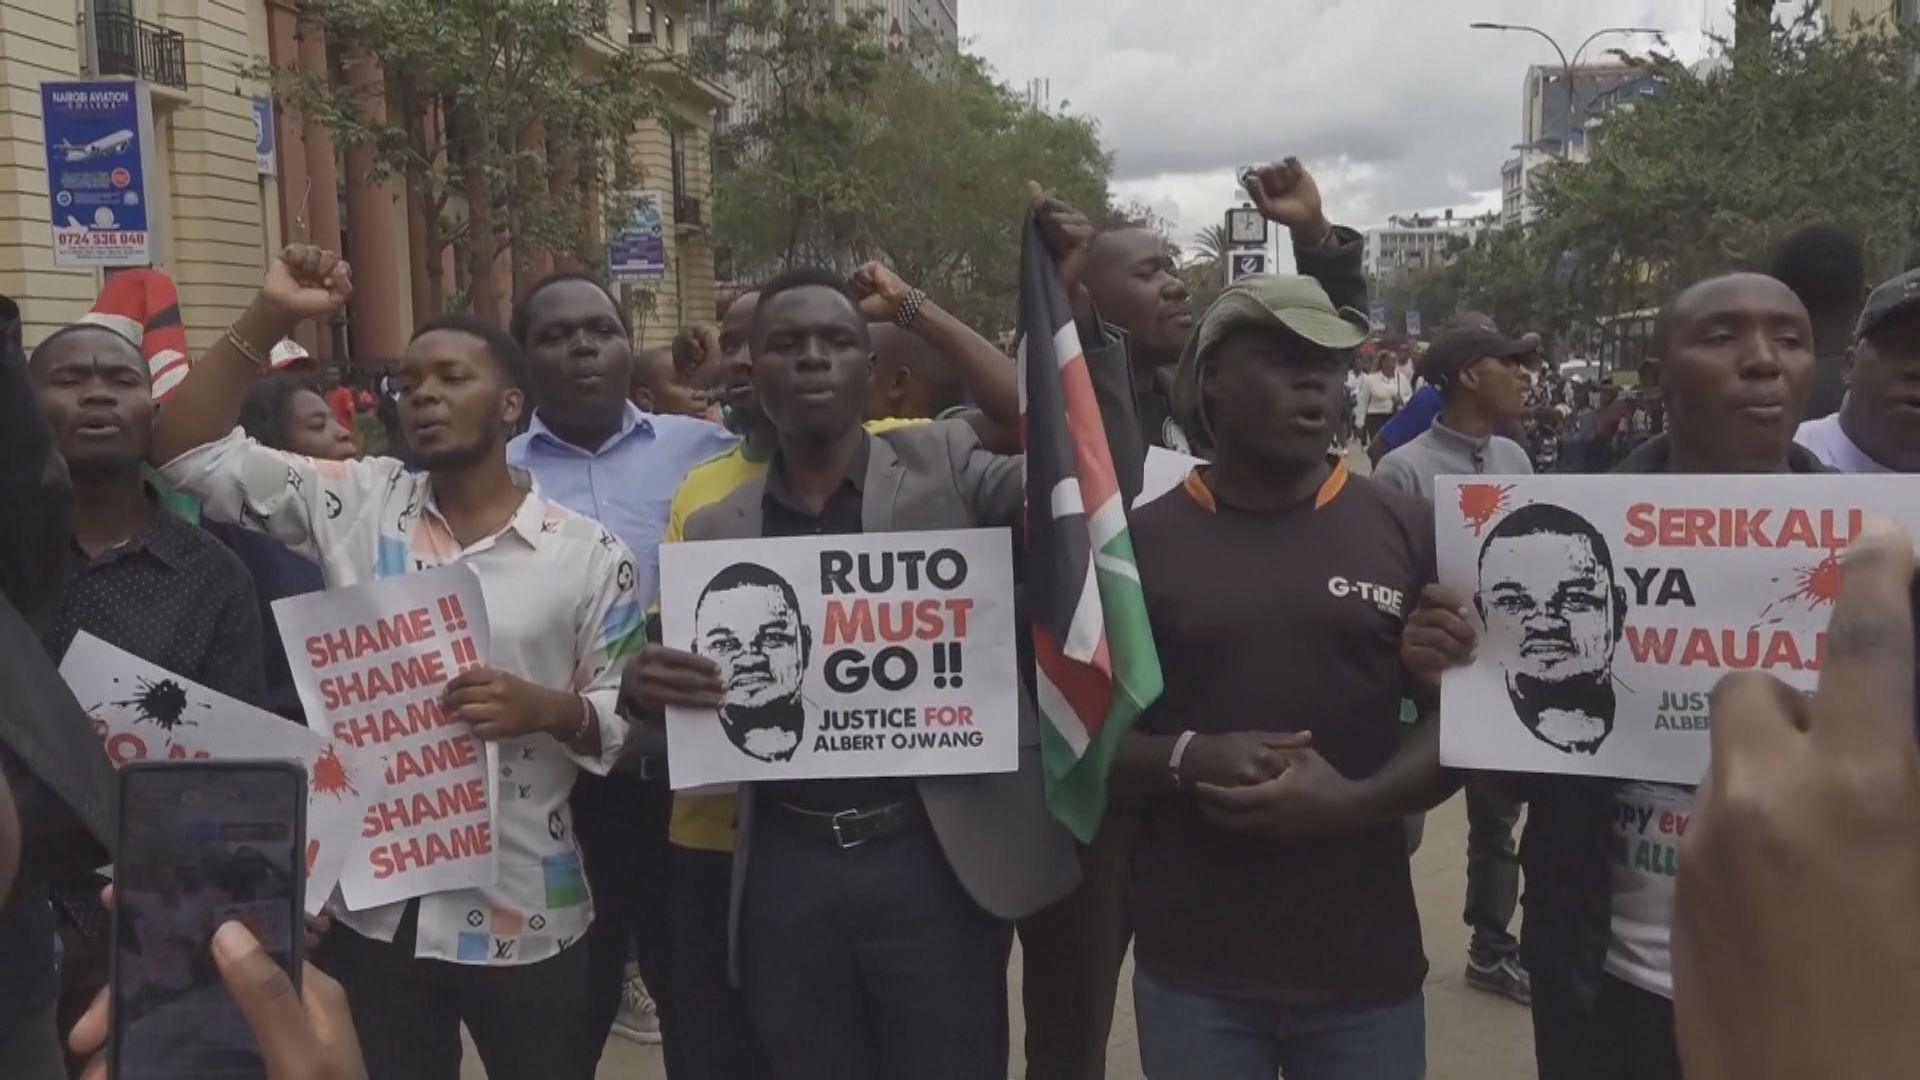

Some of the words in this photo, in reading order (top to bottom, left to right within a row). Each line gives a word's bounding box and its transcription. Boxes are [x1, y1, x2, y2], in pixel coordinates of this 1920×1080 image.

[52, 91, 88, 104] NAIROBI
[89, 91, 129, 104] AVIATION
[58, 232, 90, 246] 0724
[1623, 502, 1863, 549] SERIKALI
[820, 548, 968, 595] RUTO
[1623, 567, 1697, 607] YA
[305, 607, 436, 668] SHAME
[437, 594, 468, 633] !!
[822, 598, 974, 645] MUST
[823, 646, 918, 693] GO
[933, 642, 964, 689] !!
[1625, 626, 1828, 671] WAUAJ
[319, 650, 448, 711] SHAME
[451, 636, 481, 674] !!
[819, 707, 917, 732] JUSTICE
[923, 705, 974, 727] FOR
[1654, 714, 1712, 732] ALBER
[1657, 691, 1713, 712] JUST
[384, 734, 478, 785] AME
[813, 734, 886, 753] ALBERT
[891, 730, 984, 750] OJWANG
[361, 778, 487, 838] SHAME
[369, 822, 492, 879] SHAME
